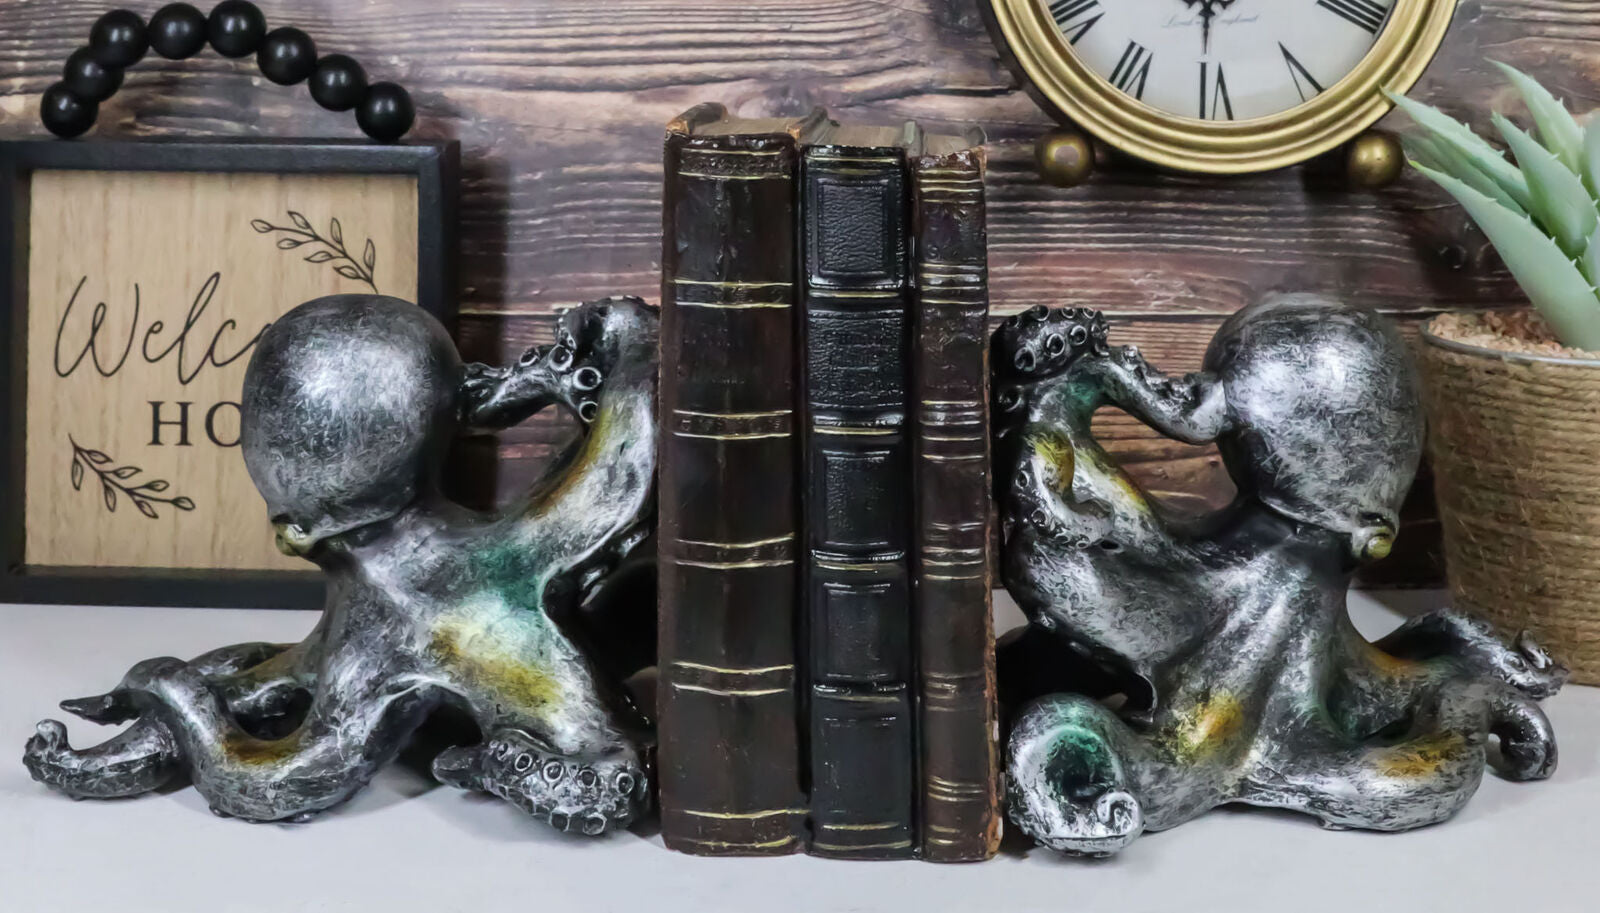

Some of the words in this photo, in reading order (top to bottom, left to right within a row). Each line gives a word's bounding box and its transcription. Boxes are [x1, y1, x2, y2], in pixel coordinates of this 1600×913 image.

[1108, 40, 1153, 101] VII
[1197, 61, 1234, 120] VI
[1278, 41, 1327, 102] V
[54, 271, 274, 385] Welc
[146, 400, 242, 447] HO
